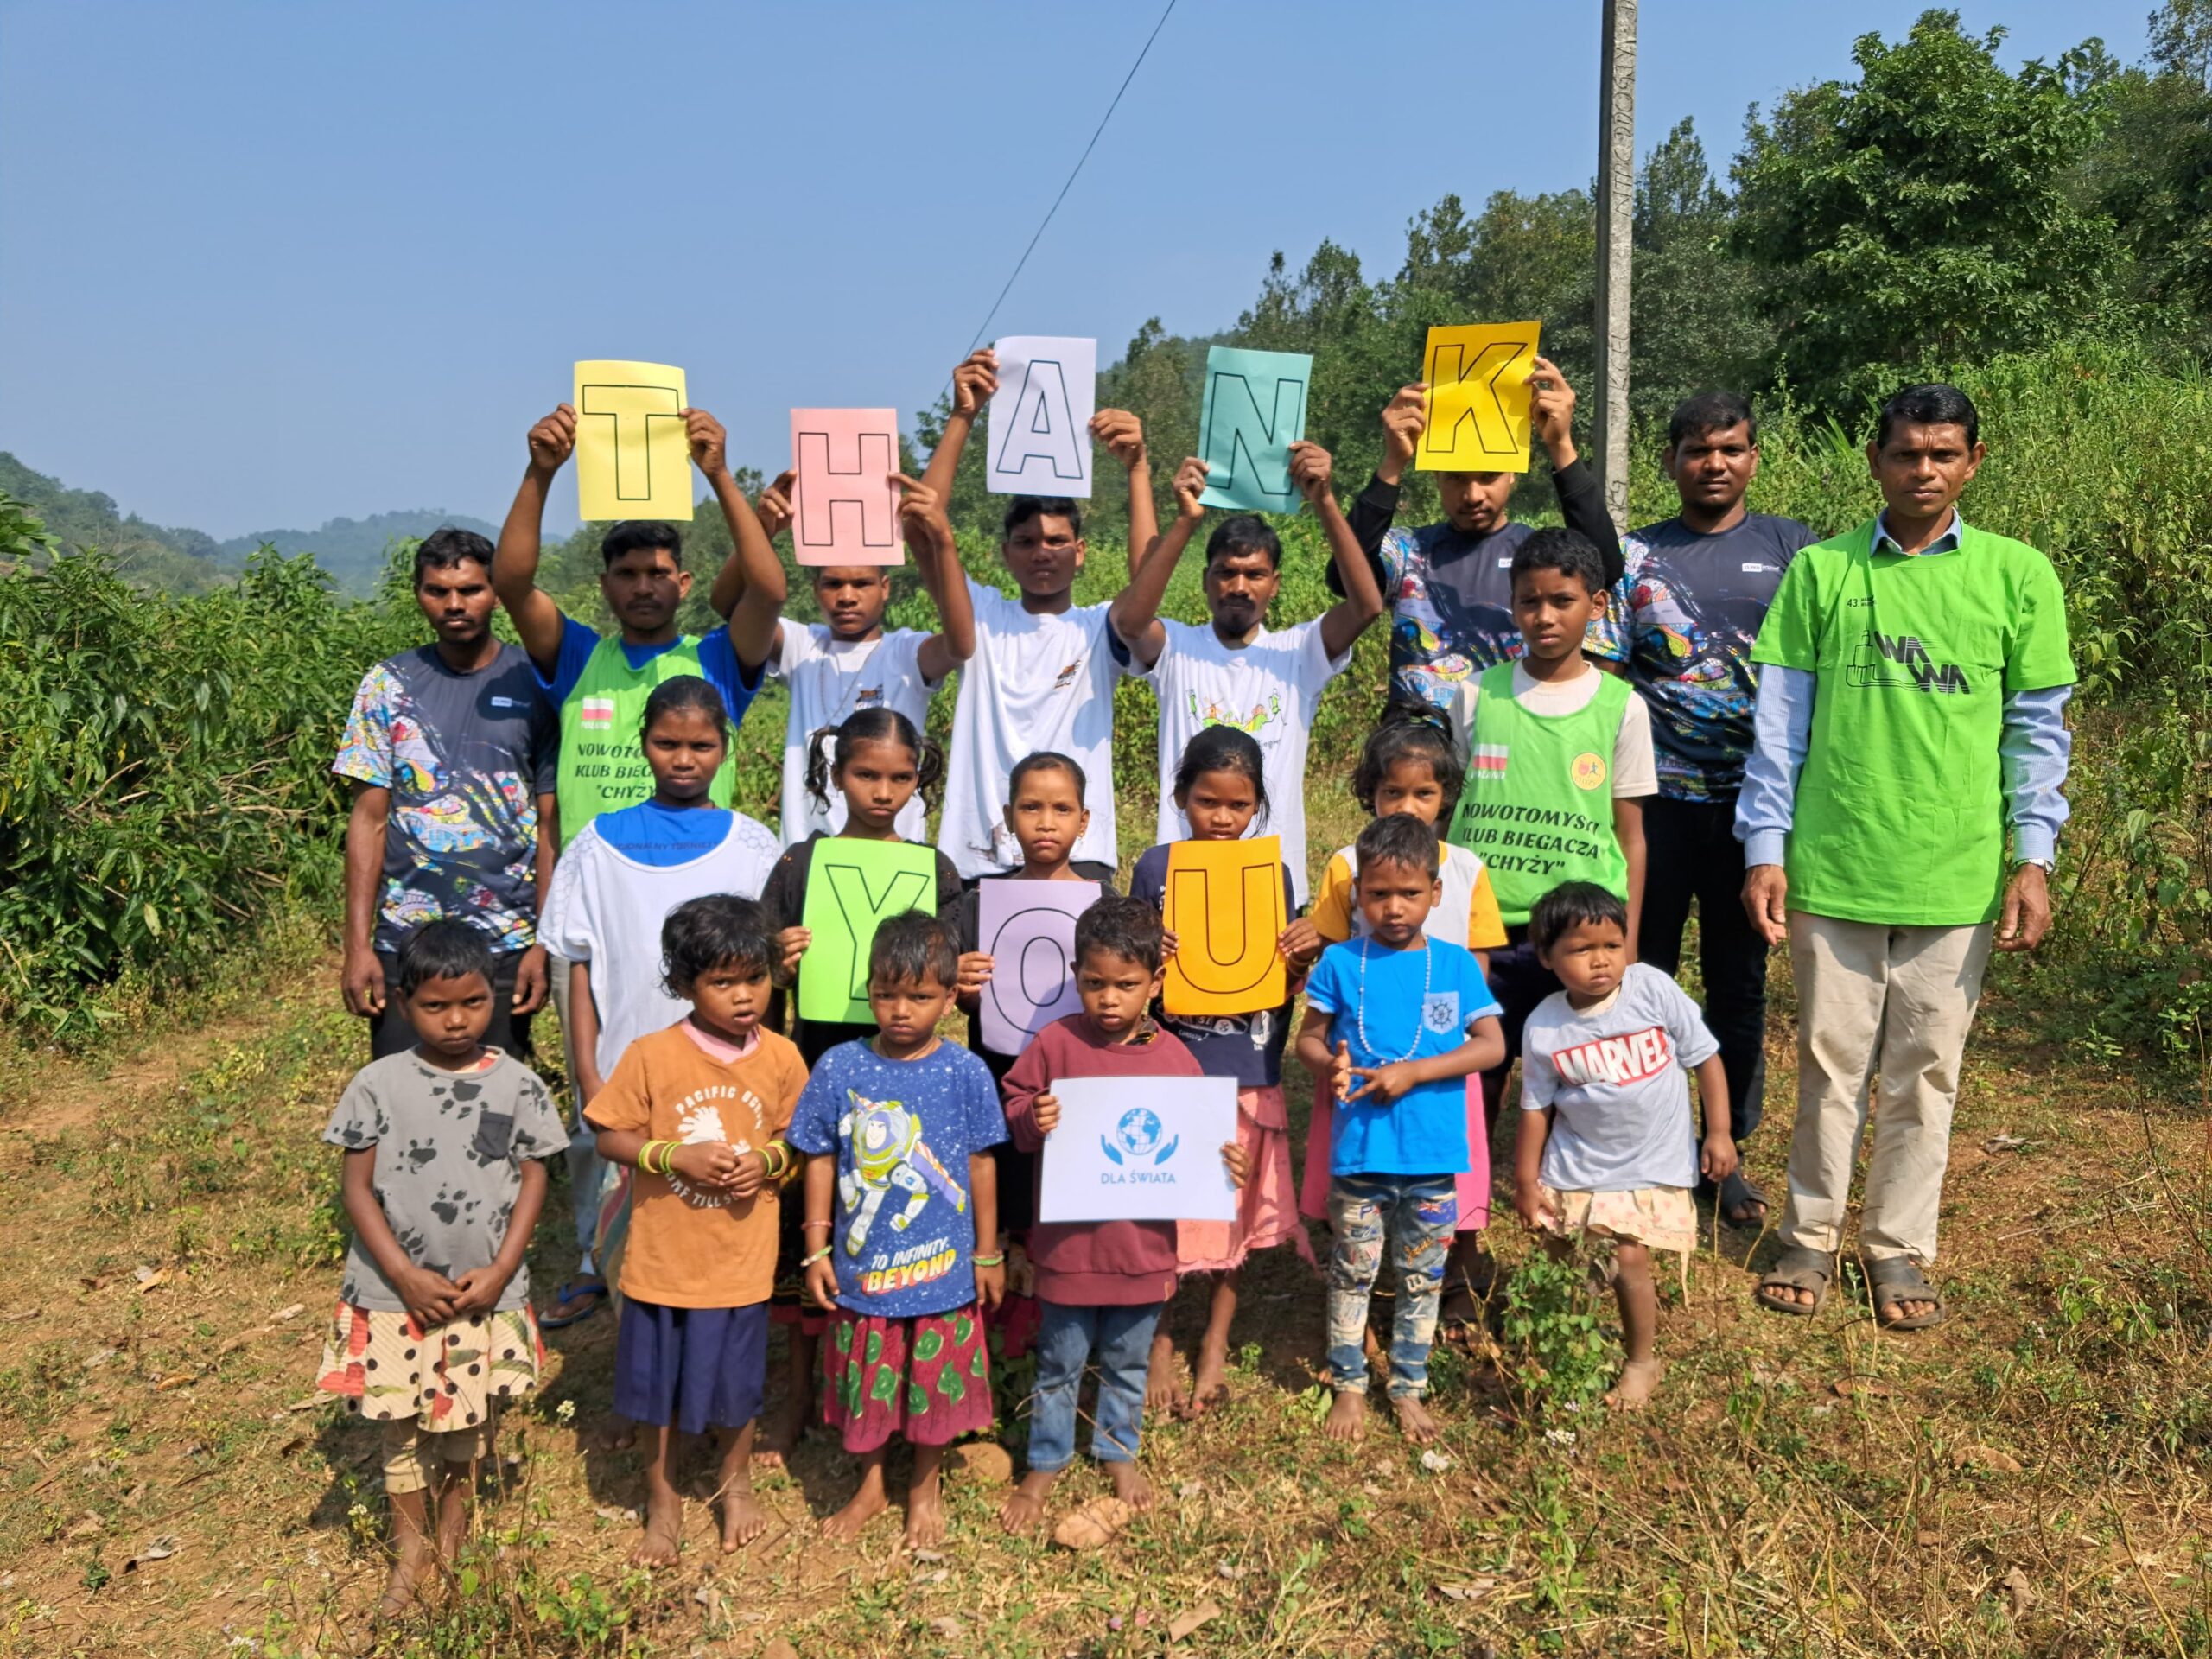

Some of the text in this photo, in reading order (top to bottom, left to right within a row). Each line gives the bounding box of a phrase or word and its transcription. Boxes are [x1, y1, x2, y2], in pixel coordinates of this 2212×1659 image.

[582, 342, 1529, 547] T H A N K
[575, 764, 610, 778] KLUB
[1501, 830, 1599, 860] BIEGACZA
[825, 862, 1277, 1035] Y O U
[1556, 1027, 1669, 1085] MARVEL
[675, 1084, 737, 1116] PACIFIC
[1101, 1169, 1176, 1185] DLA ŚWIATA
[692, 1192, 721, 1208] TILL
[871, 1236, 949, 1270] TO INFINITY
[864, 1249, 957, 1294] BEYOND
